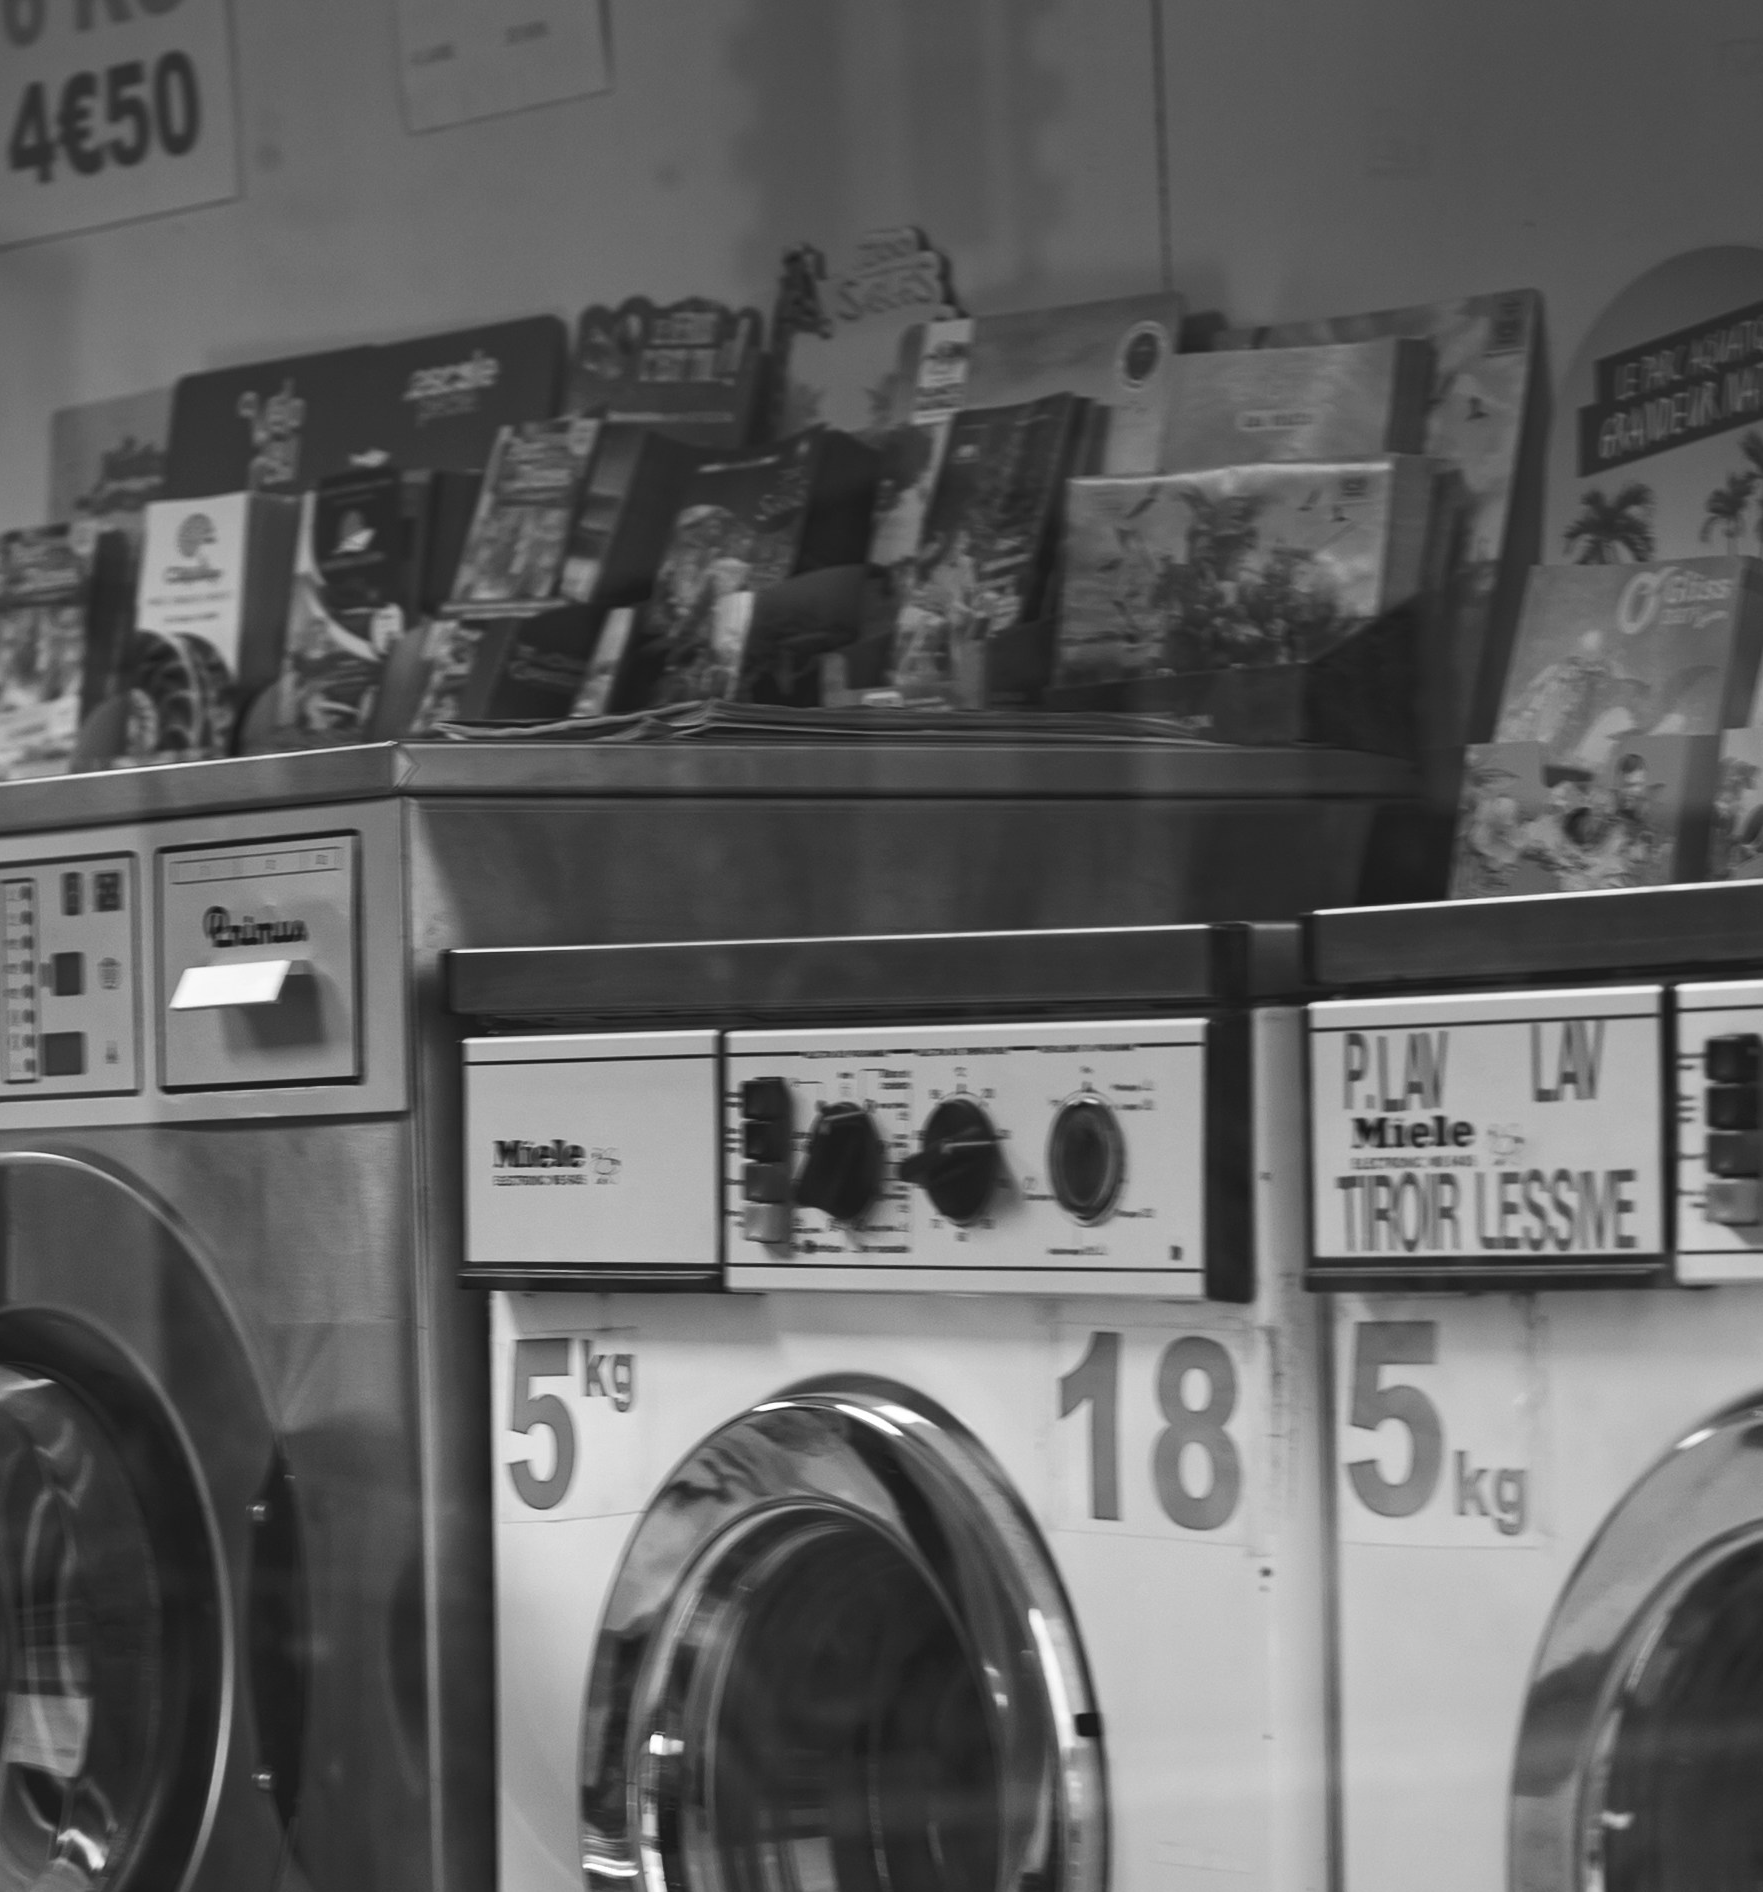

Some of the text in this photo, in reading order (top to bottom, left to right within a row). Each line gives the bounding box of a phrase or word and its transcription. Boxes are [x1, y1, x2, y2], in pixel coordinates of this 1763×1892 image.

[7, 48, 204, 184] 4€50
[1530, 1019, 1606, 1103] LAV
[492, 1138, 587, 1168] Miele
[1350, 1114, 1477, 1149] Miele
[1334, 1168, 1638, 1252] TIROIR LESSIVE
[1059, 1331, 1242, 1530] 18
